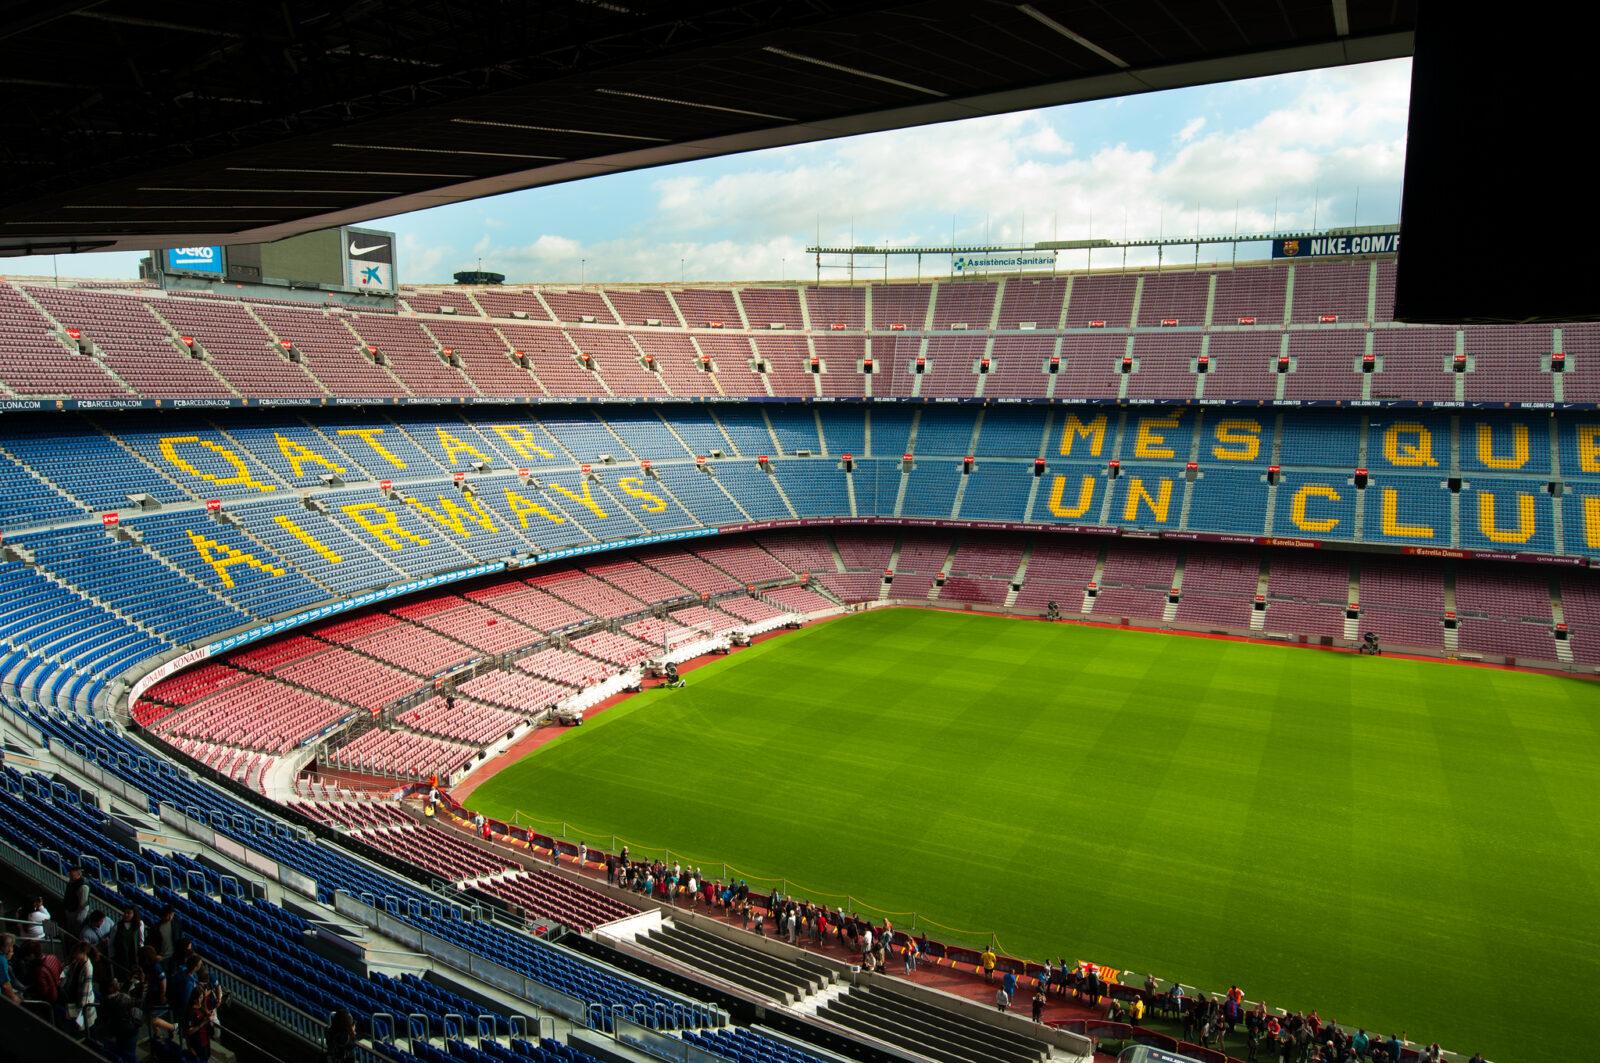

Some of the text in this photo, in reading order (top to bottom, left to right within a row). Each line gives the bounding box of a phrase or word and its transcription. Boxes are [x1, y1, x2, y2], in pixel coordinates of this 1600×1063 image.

[1310, 234, 1400, 255] NIKE.COM/F
[967, 258, 1015, 266] Assistència
[78, 400, 142, 408] FCBARCELONA.COM
[158, 426, 554, 492] QATAR
[1048, 476, 1173, 522] UN
[186, 478, 667, 589] AIRWAYS
[1295, 540, 1314, 548] Damm
[1416, 548, 1442, 556] Estrella
[173, 649, 205, 669] KONAMI
[142, 667, 165, 687] KONAMI
